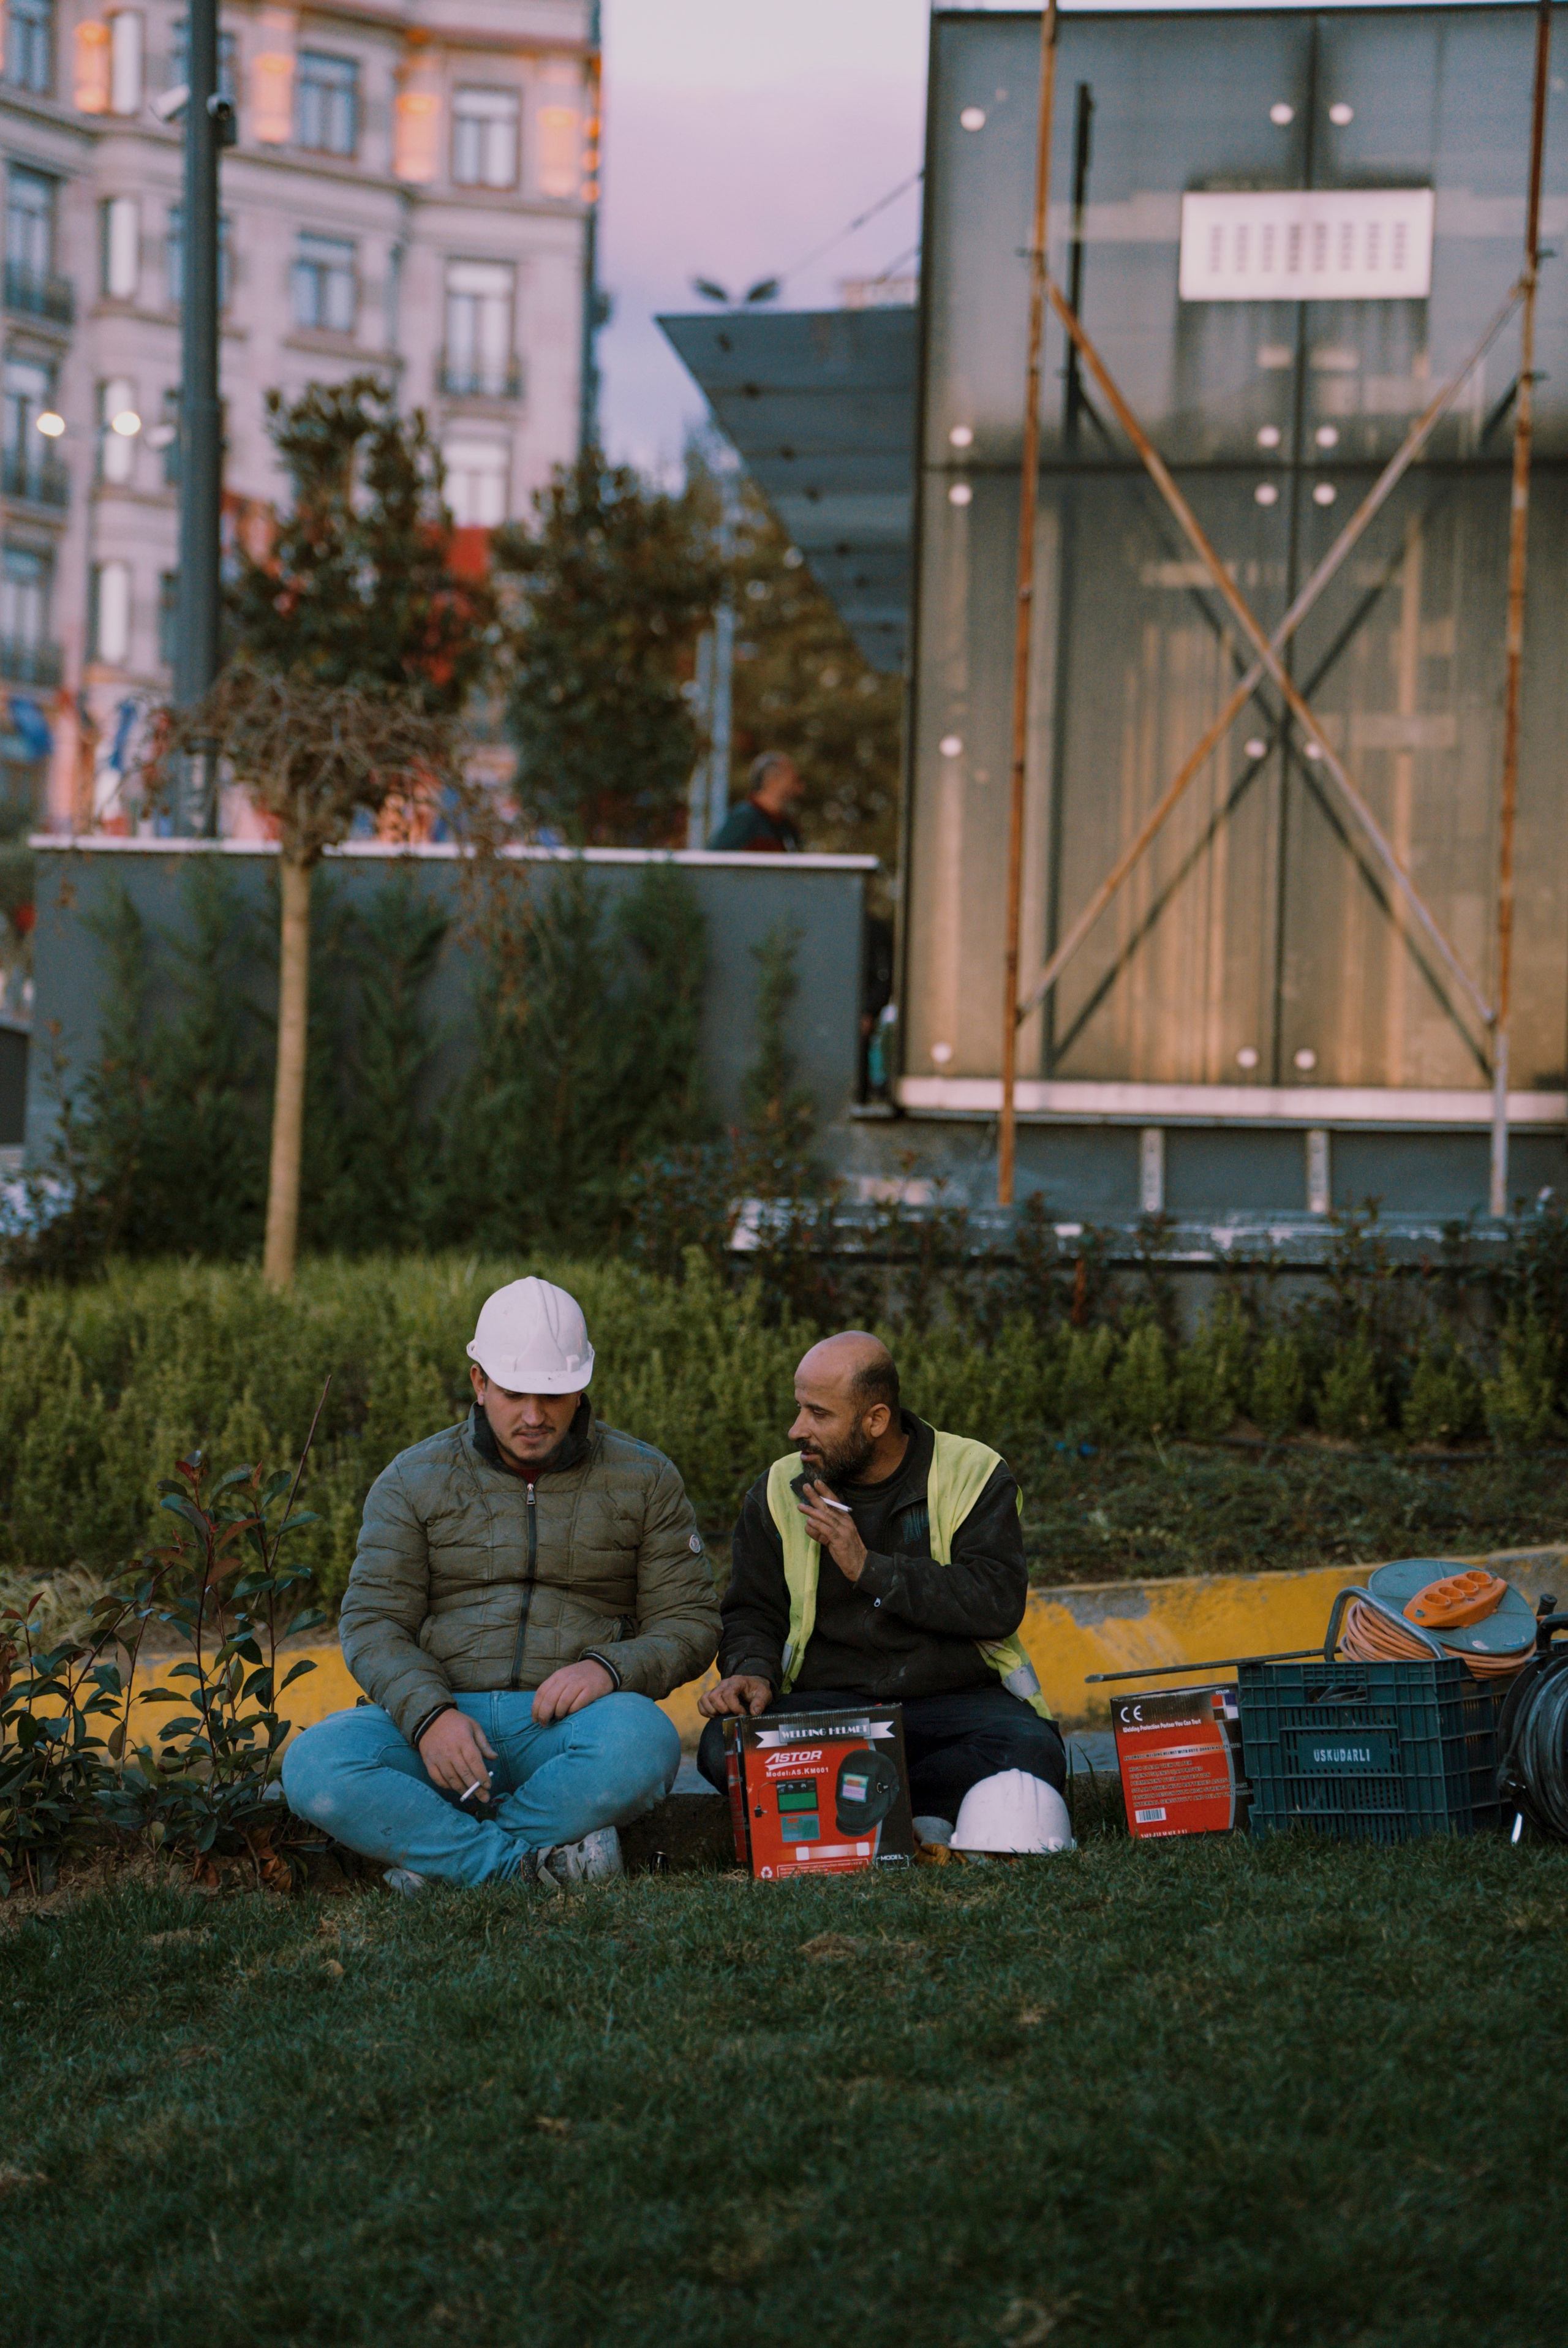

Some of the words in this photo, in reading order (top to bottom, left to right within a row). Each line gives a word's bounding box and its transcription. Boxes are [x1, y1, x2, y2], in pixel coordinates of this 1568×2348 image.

[1120, 1705, 1143, 1723] CE
[782, 1728, 826, 1738] WELDING
[829, 1725, 868, 1735] HELMET
[764, 1750, 822, 1764] ASTOR
